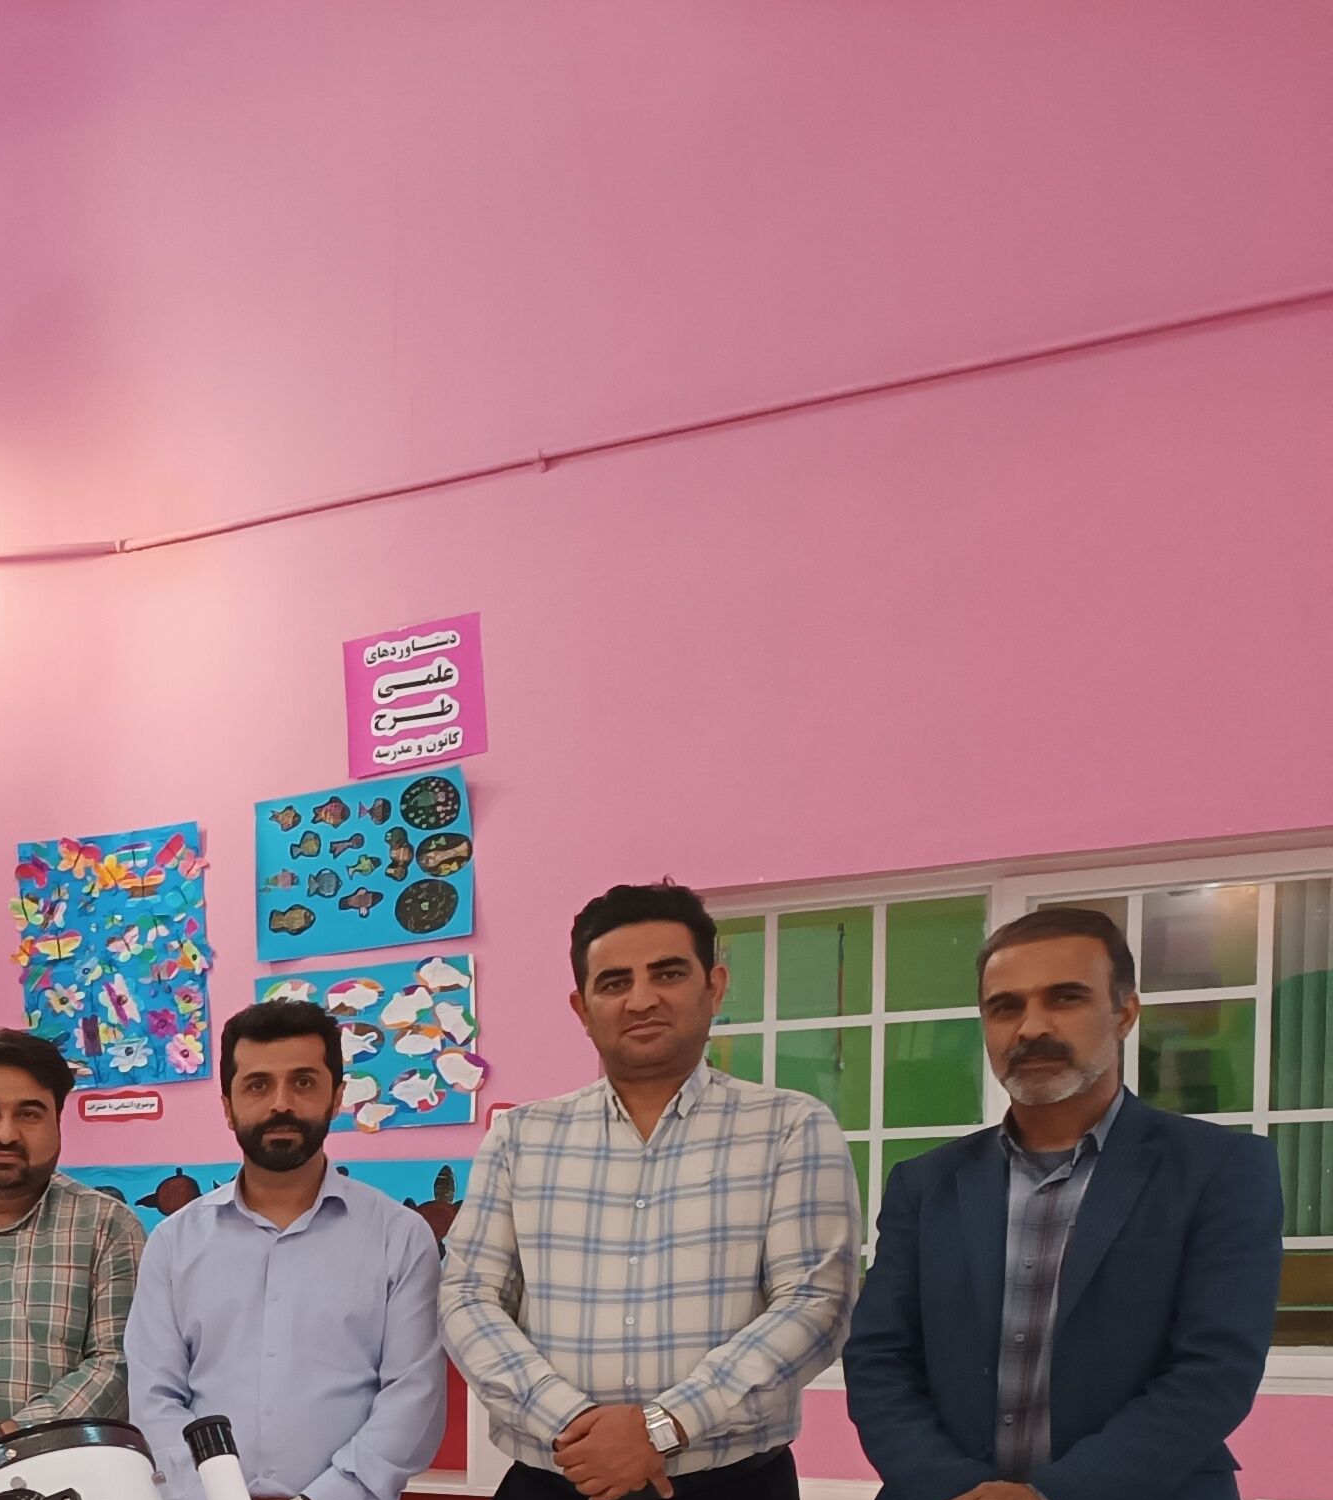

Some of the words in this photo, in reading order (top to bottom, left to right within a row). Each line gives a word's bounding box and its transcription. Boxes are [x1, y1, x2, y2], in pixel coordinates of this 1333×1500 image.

[366, 633, 456, 664] دستاوردهای
[377, 664, 454, 699] علمی
[374, 698, 453, 731] طرح
[375, 744, 413, 760] مدرسه
[416, 744, 423, 756] و
[425, 731, 460, 753] کانون
